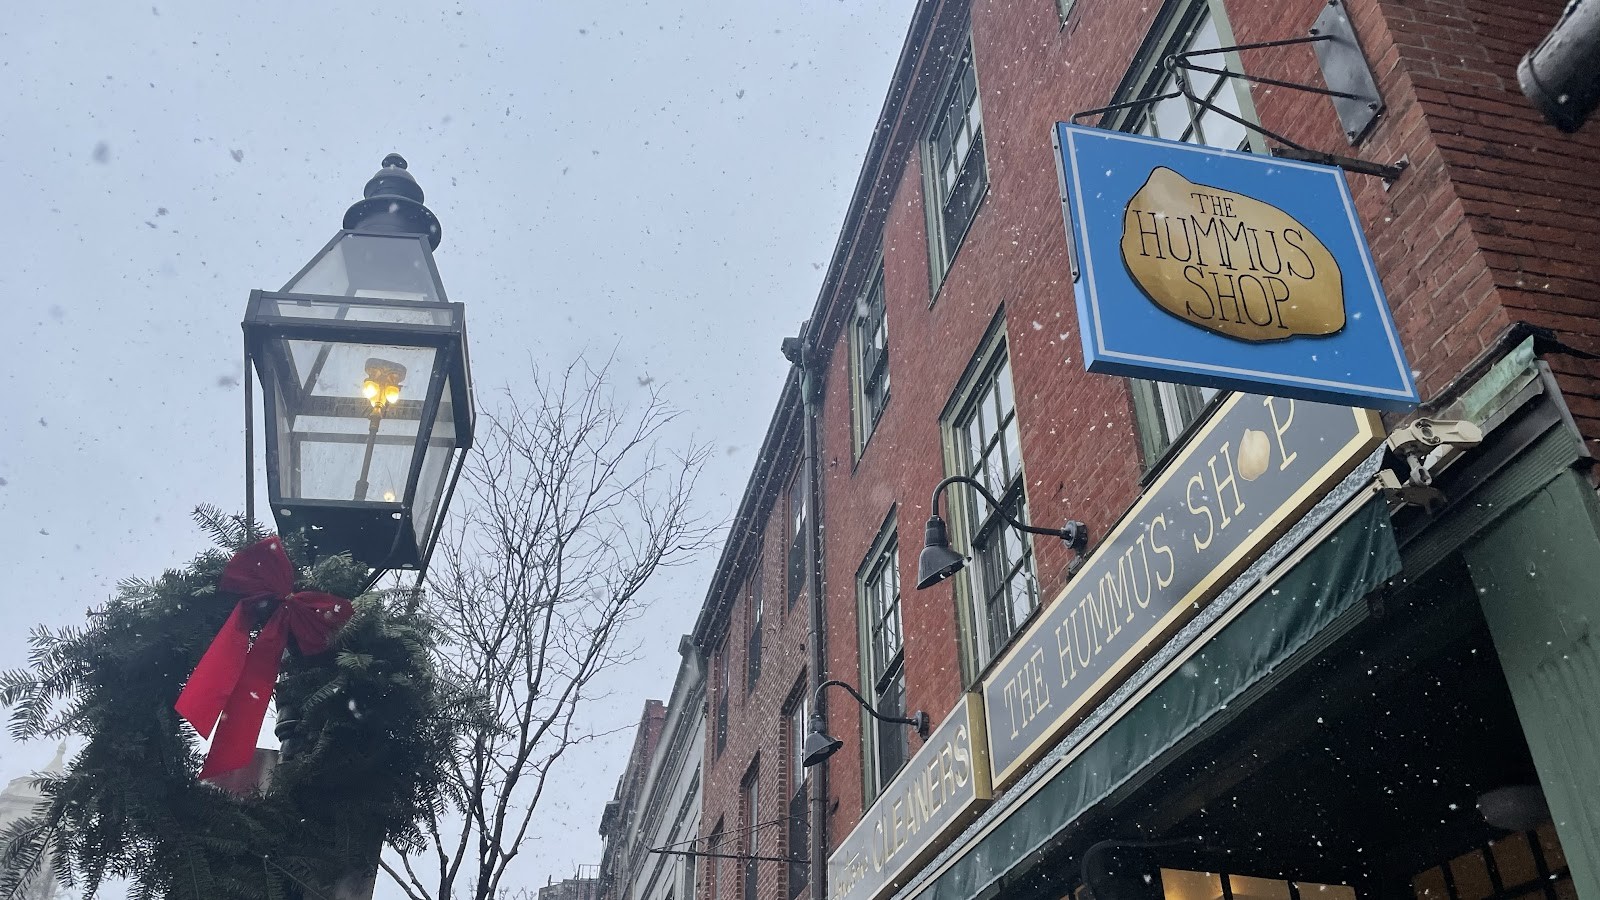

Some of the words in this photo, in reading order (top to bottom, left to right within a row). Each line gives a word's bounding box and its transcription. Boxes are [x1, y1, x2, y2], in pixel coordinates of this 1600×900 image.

[1190, 192, 1237, 218] THE
[1132, 210, 1315, 280] HUMMUS
[1183, 265, 1290, 330] SHOP
[1003, 646, 1050, 741] THE
[1054, 512, 1175, 689] HUMMUS
[872, 724, 970, 873] CLEANERS
